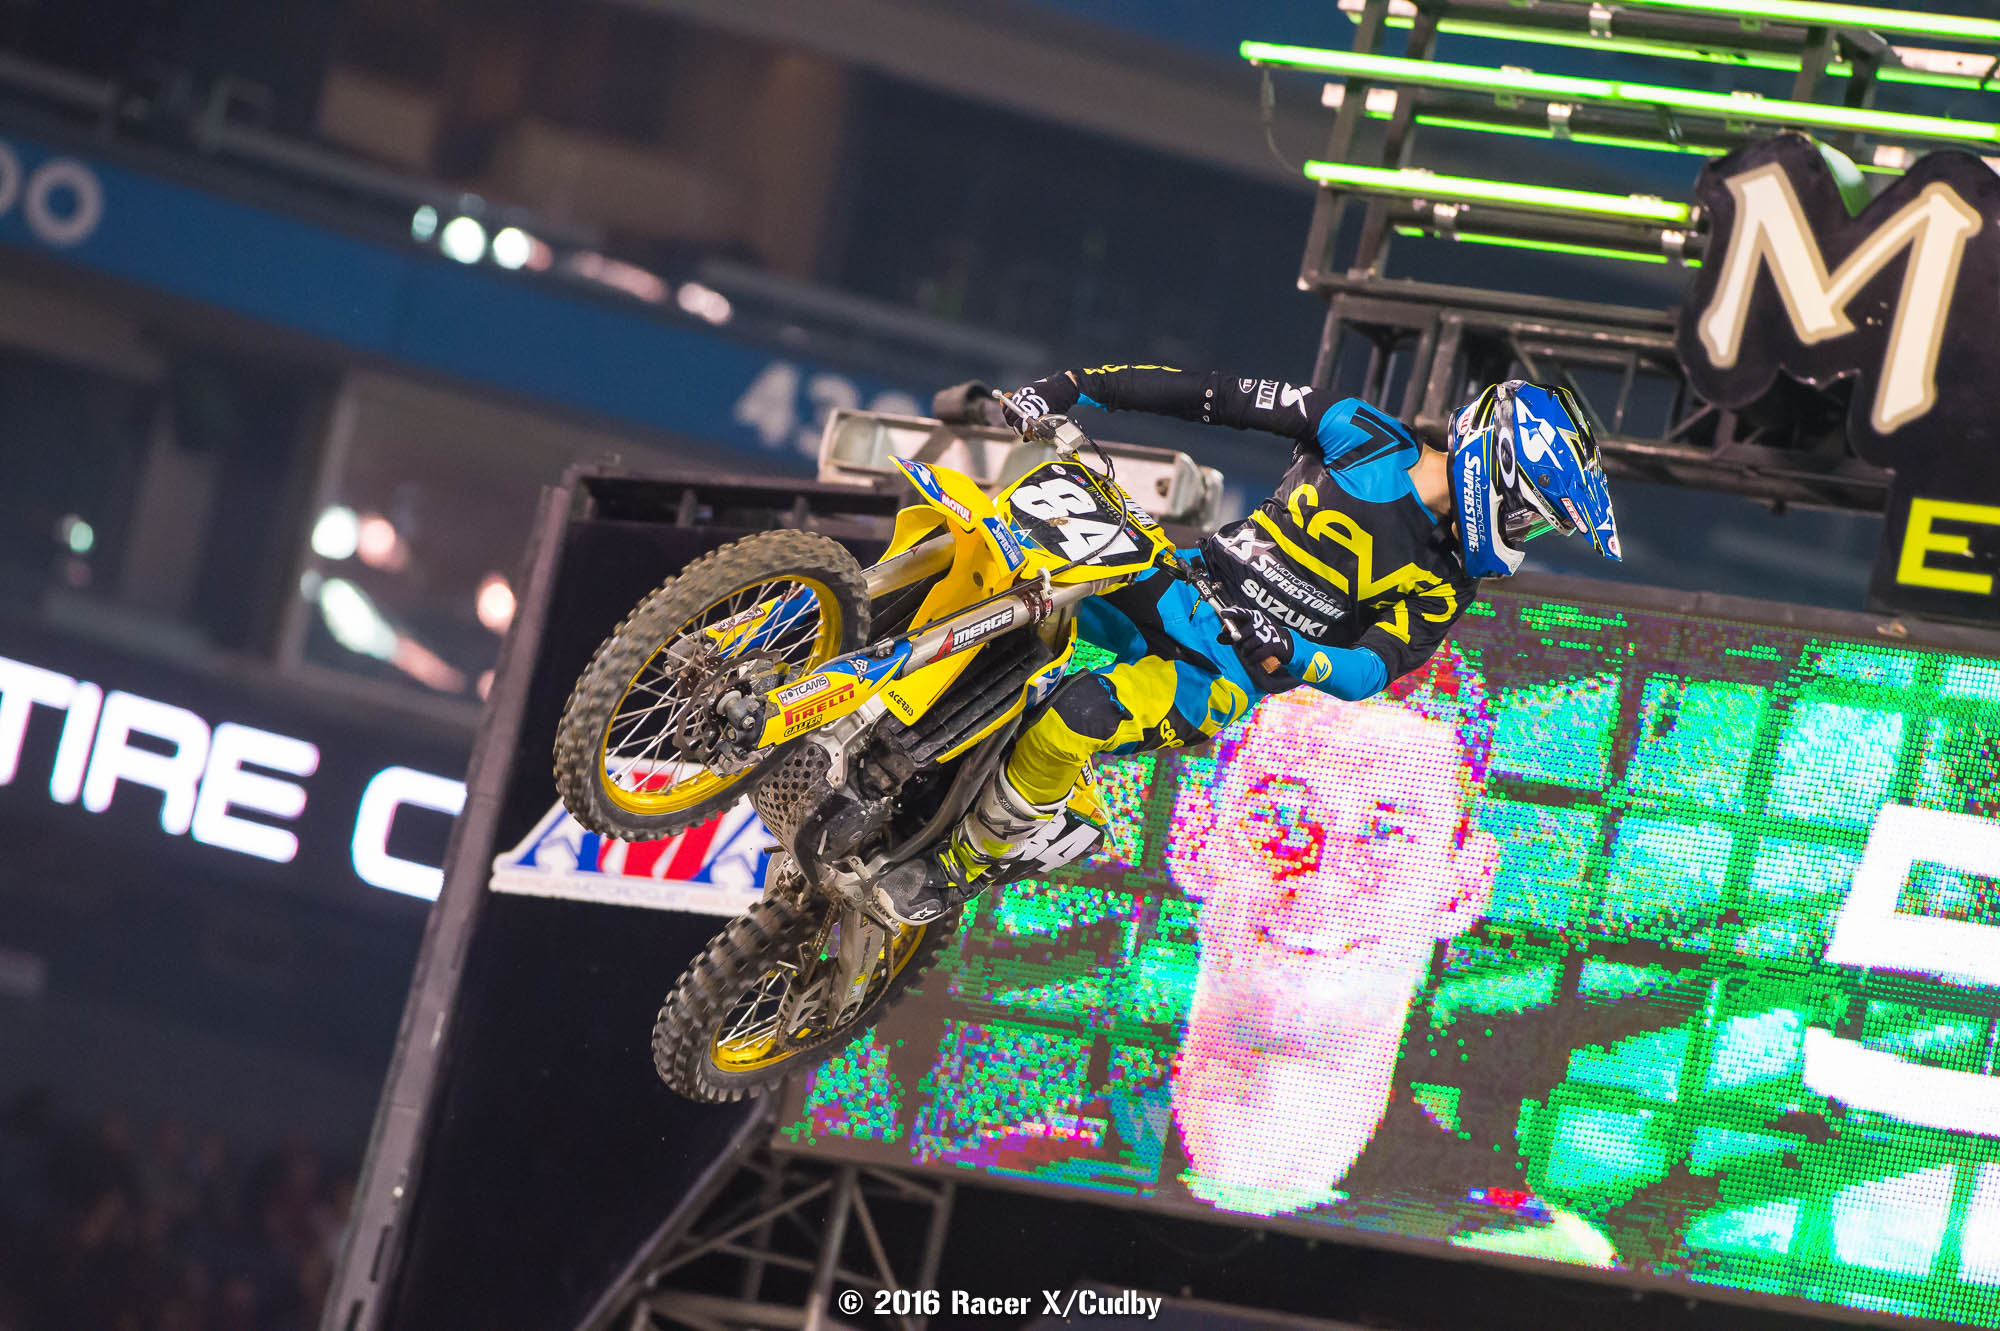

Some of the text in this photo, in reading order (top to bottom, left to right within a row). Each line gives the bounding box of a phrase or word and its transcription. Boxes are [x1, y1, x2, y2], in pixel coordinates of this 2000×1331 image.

[1698, 161, 1983, 435] M
[941, 494, 970, 522] MOTUL
[1010, 478, 1139, 566] 84
[1474, 476, 1487, 542] MOTORCYCLE
[1896, 497, 2000, 595] E
[1273, 563, 1336, 605] MOTORCYCLE
[953, 609, 1013, 645] MERGE
[1241, 579, 1328, 638] SUZUKI
[780, 676, 827, 703] HOTCAMS
[785, 683, 854, 727] PIRELLI
[888, 690, 914, 717] ACERBIS
